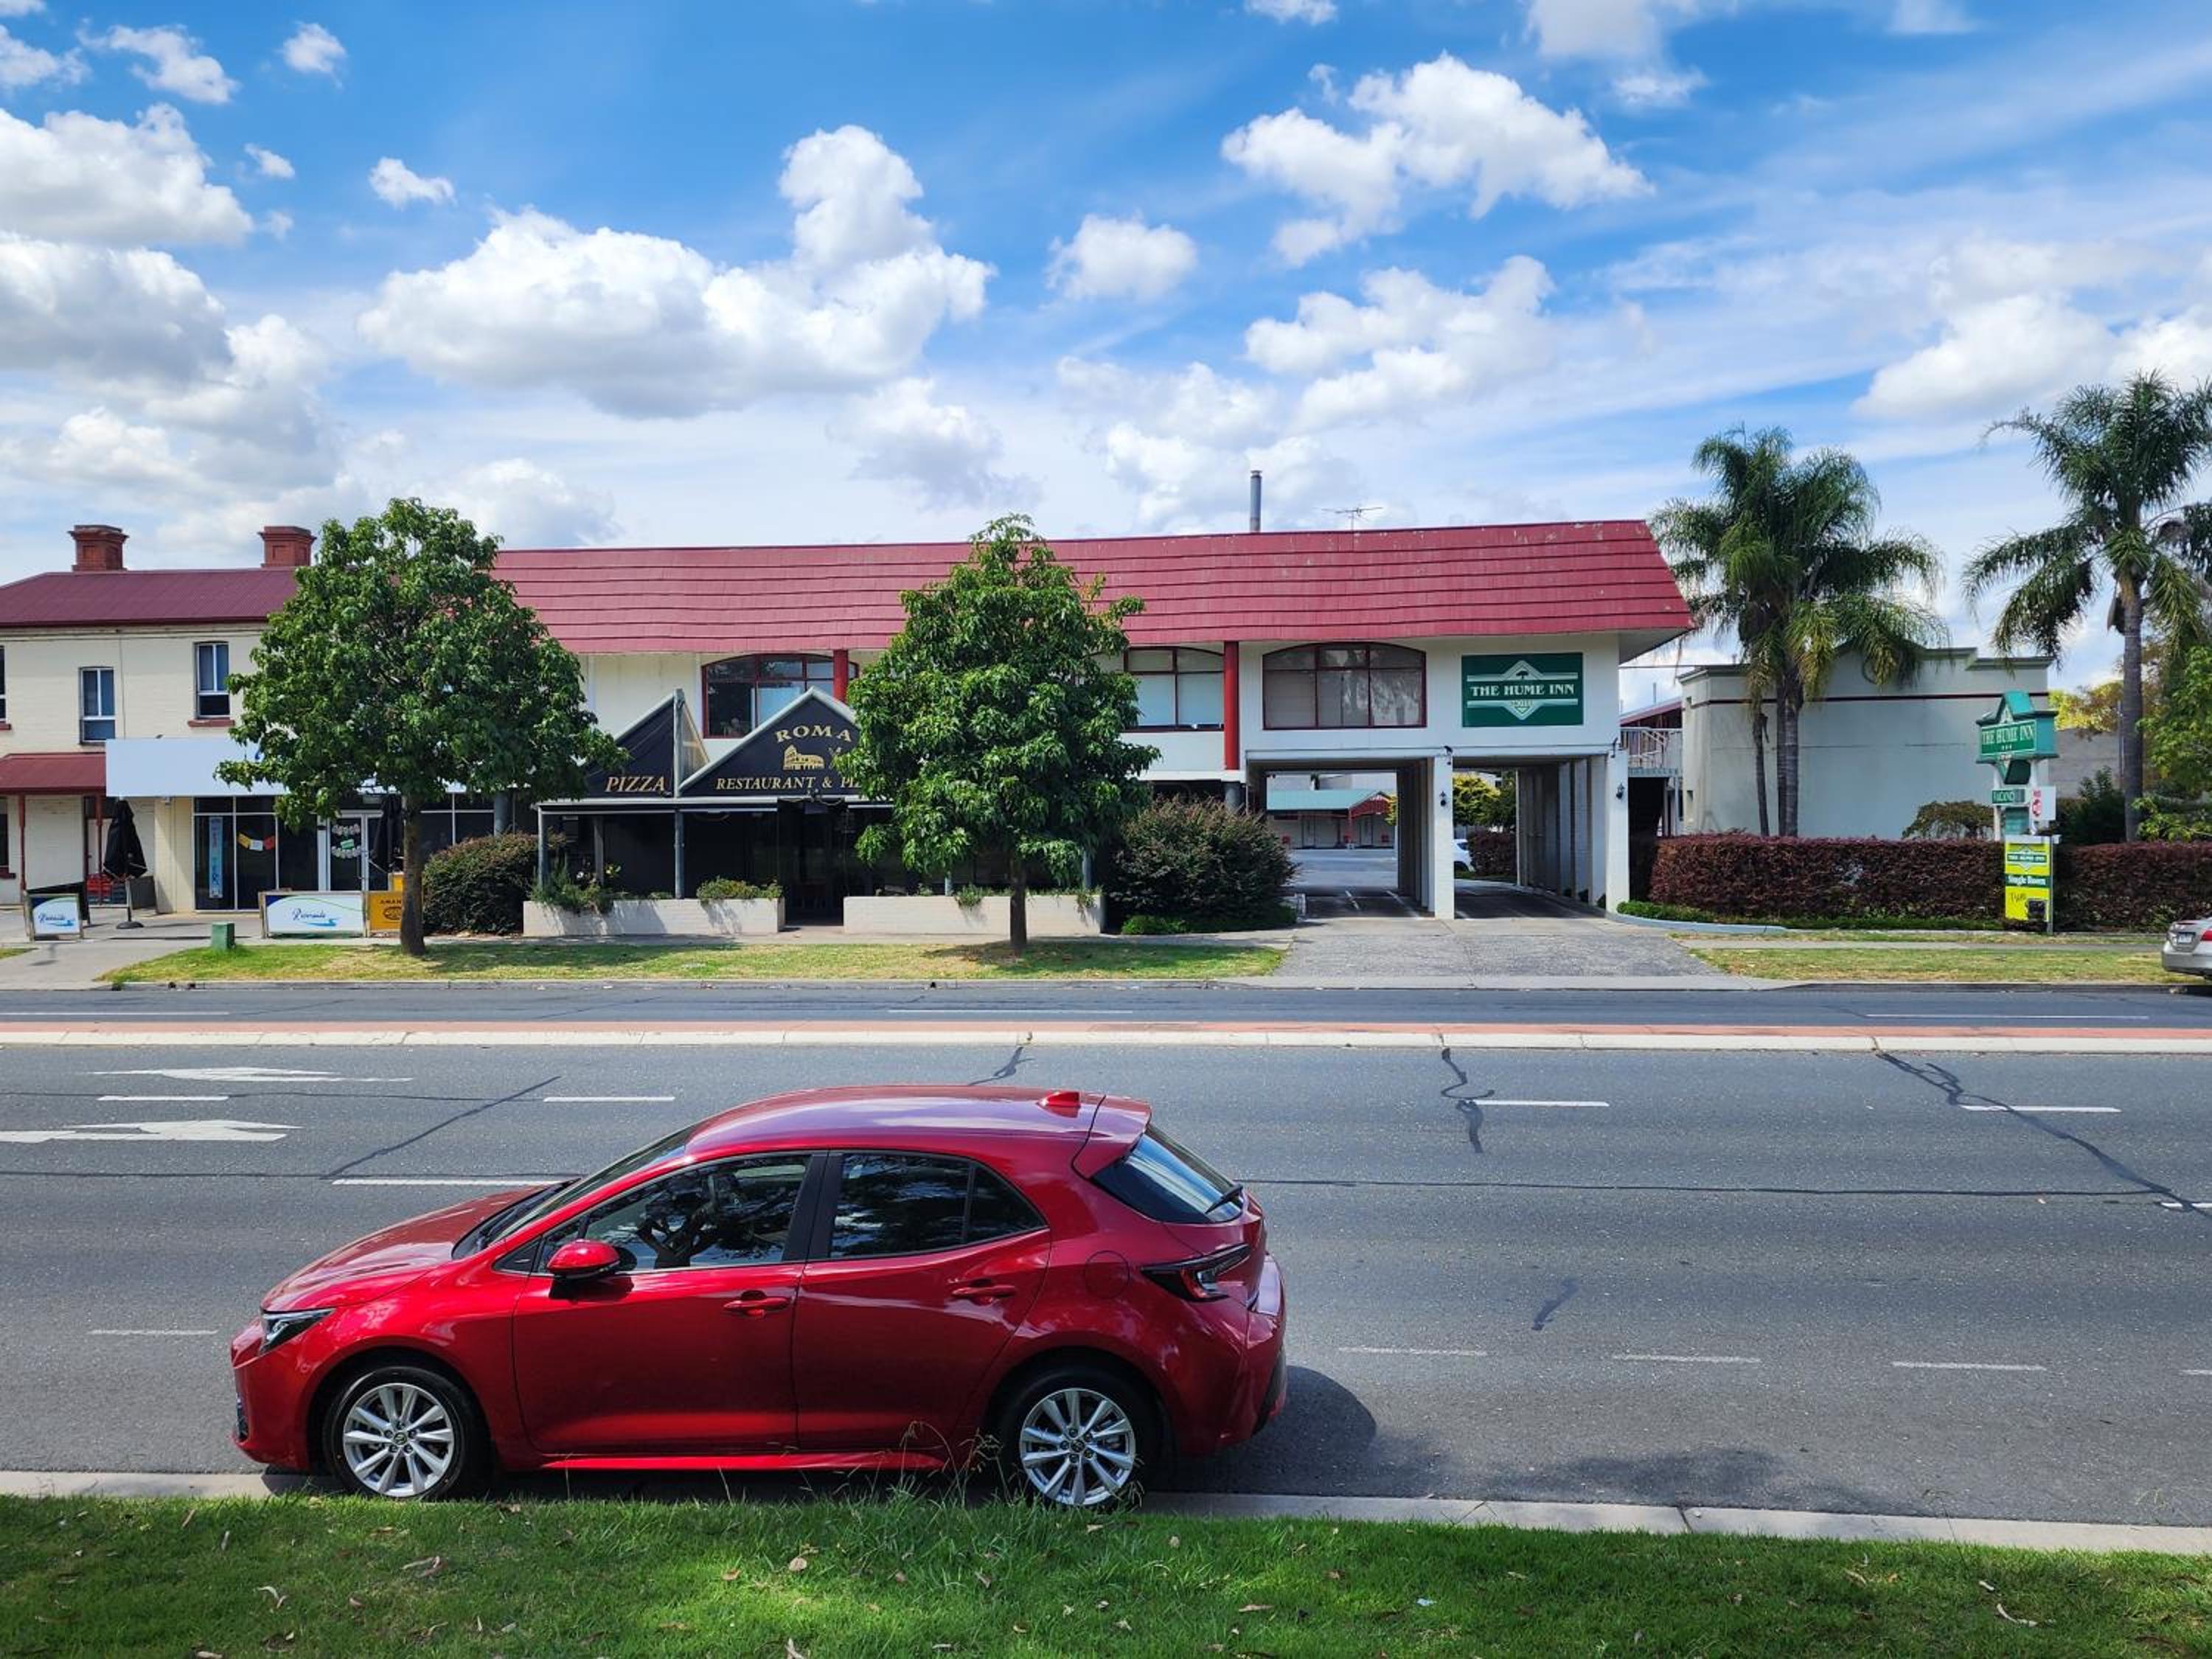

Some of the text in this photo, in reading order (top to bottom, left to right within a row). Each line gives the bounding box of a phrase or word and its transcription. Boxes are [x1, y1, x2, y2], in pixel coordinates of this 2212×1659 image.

[1470, 684, 1574, 697] THE HUME INN
[776, 725, 852, 742] ROMA
[605, 776, 665, 792] PIZZA
[715, 776, 816, 790] RESTAURANT
[822, 776, 832, 788] &
